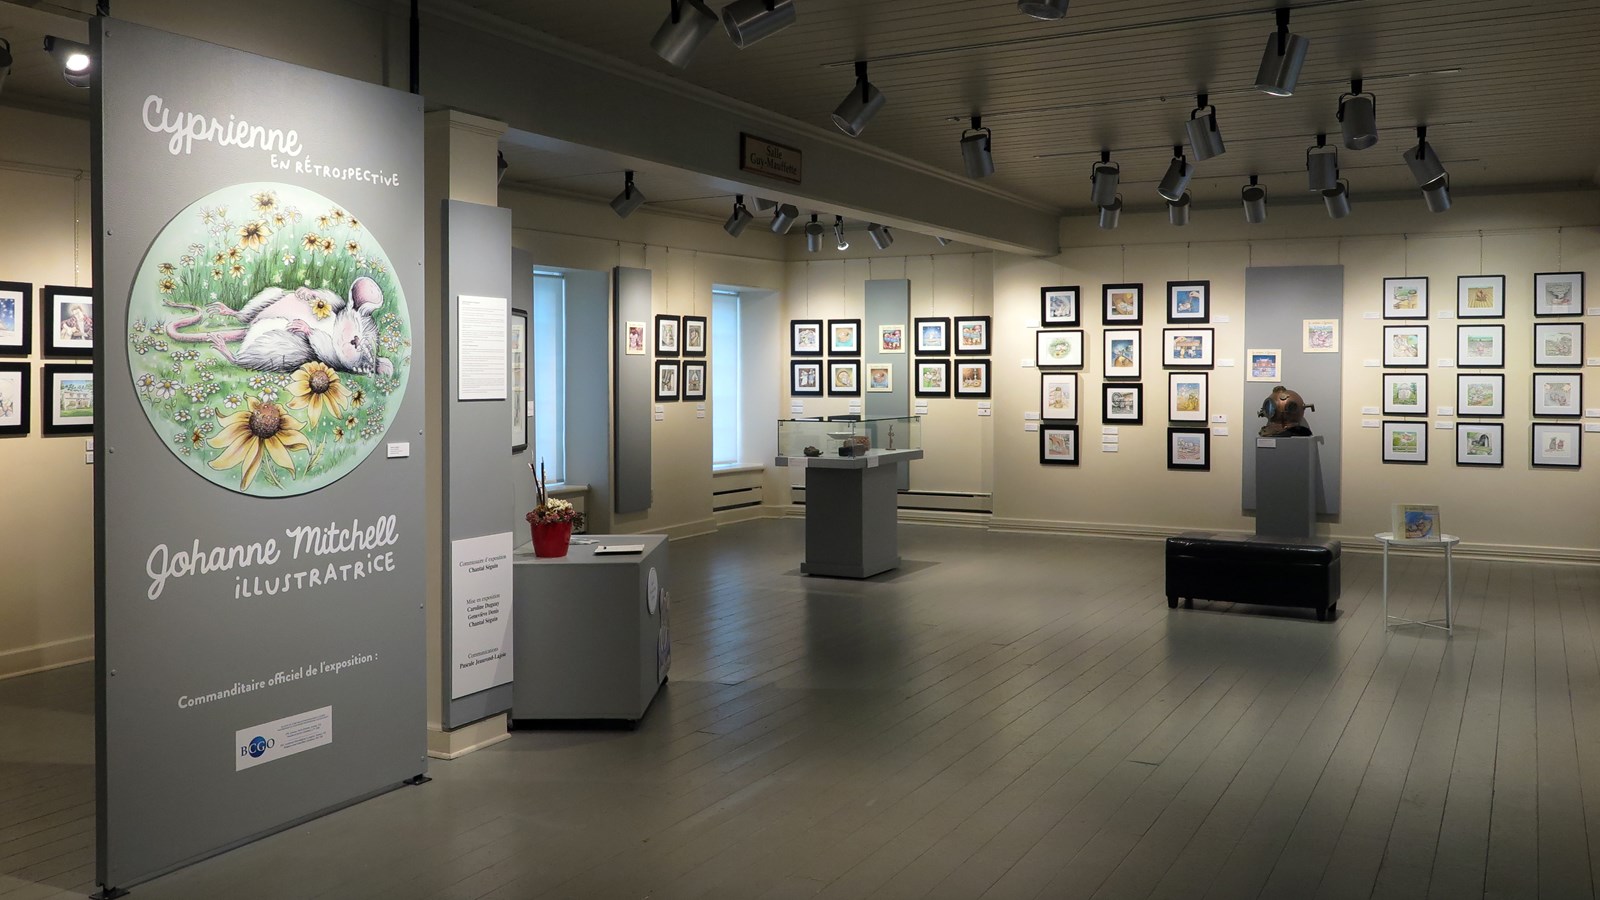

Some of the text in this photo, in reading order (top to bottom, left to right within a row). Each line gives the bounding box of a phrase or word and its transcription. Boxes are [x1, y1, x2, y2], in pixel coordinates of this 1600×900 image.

[142, 94, 303, 157] Cyprienne
[766, 145, 783, 160] Salle
[270, 154, 290, 170] EN
[145, 514, 400, 601] Johanne Mitchell
[466, 604, 484, 613] Caroline
[468, 619, 485, 628] Chantal
[177, 679, 265, 709] Commanditaire
[268, 667, 304, 687] officiel
[305, 664, 318, 677] de
[320, 654, 373, 675] l'exposition
[240, 738, 275, 757] BCGO
